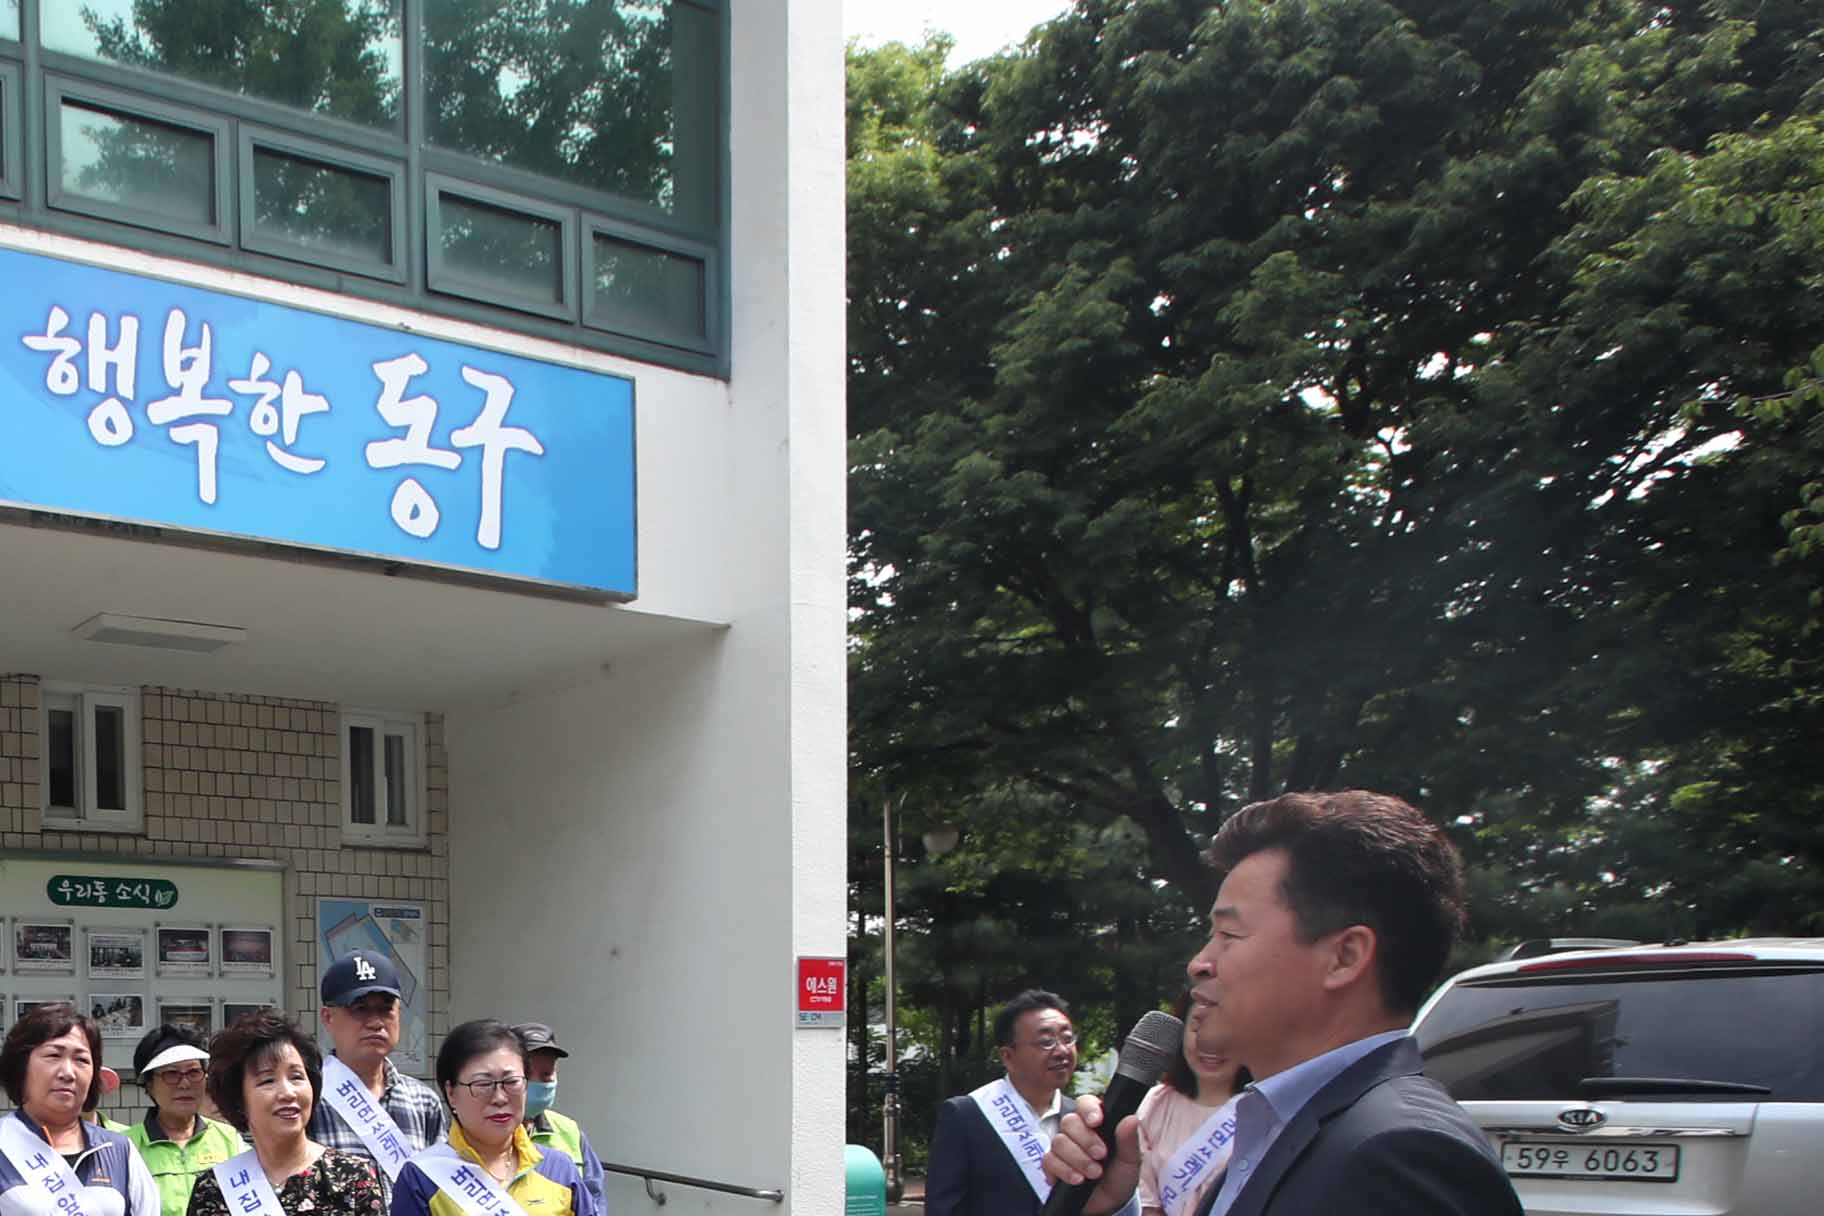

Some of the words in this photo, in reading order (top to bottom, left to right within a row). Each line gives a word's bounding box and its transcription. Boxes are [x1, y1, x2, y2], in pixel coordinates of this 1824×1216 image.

[22, 306, 329, 504] 행복한
[366, 352, 543, 548] 동구
[58, 880, 108, 903] 우리동
[115, 883, 150, 904] 소식
[353, 956, 376, 981] LA
[806, 976, 837, 994] 에스원
[336, 1079, 378, 1126] 버리면
[1561, 1109, 1600, 1123] KIA
[24, 1150, 50, 1172] 내
[42, 1172, 67, 1195] 집
[1516, 1147, 1569, 1170] 59우
[1584, 1149, 1658, 1173] 6063
[228, 1168, 251, 1190] 내
[449, 1164, 497, 1211] 버리면
[237, 1189, 262, 1212] 집
